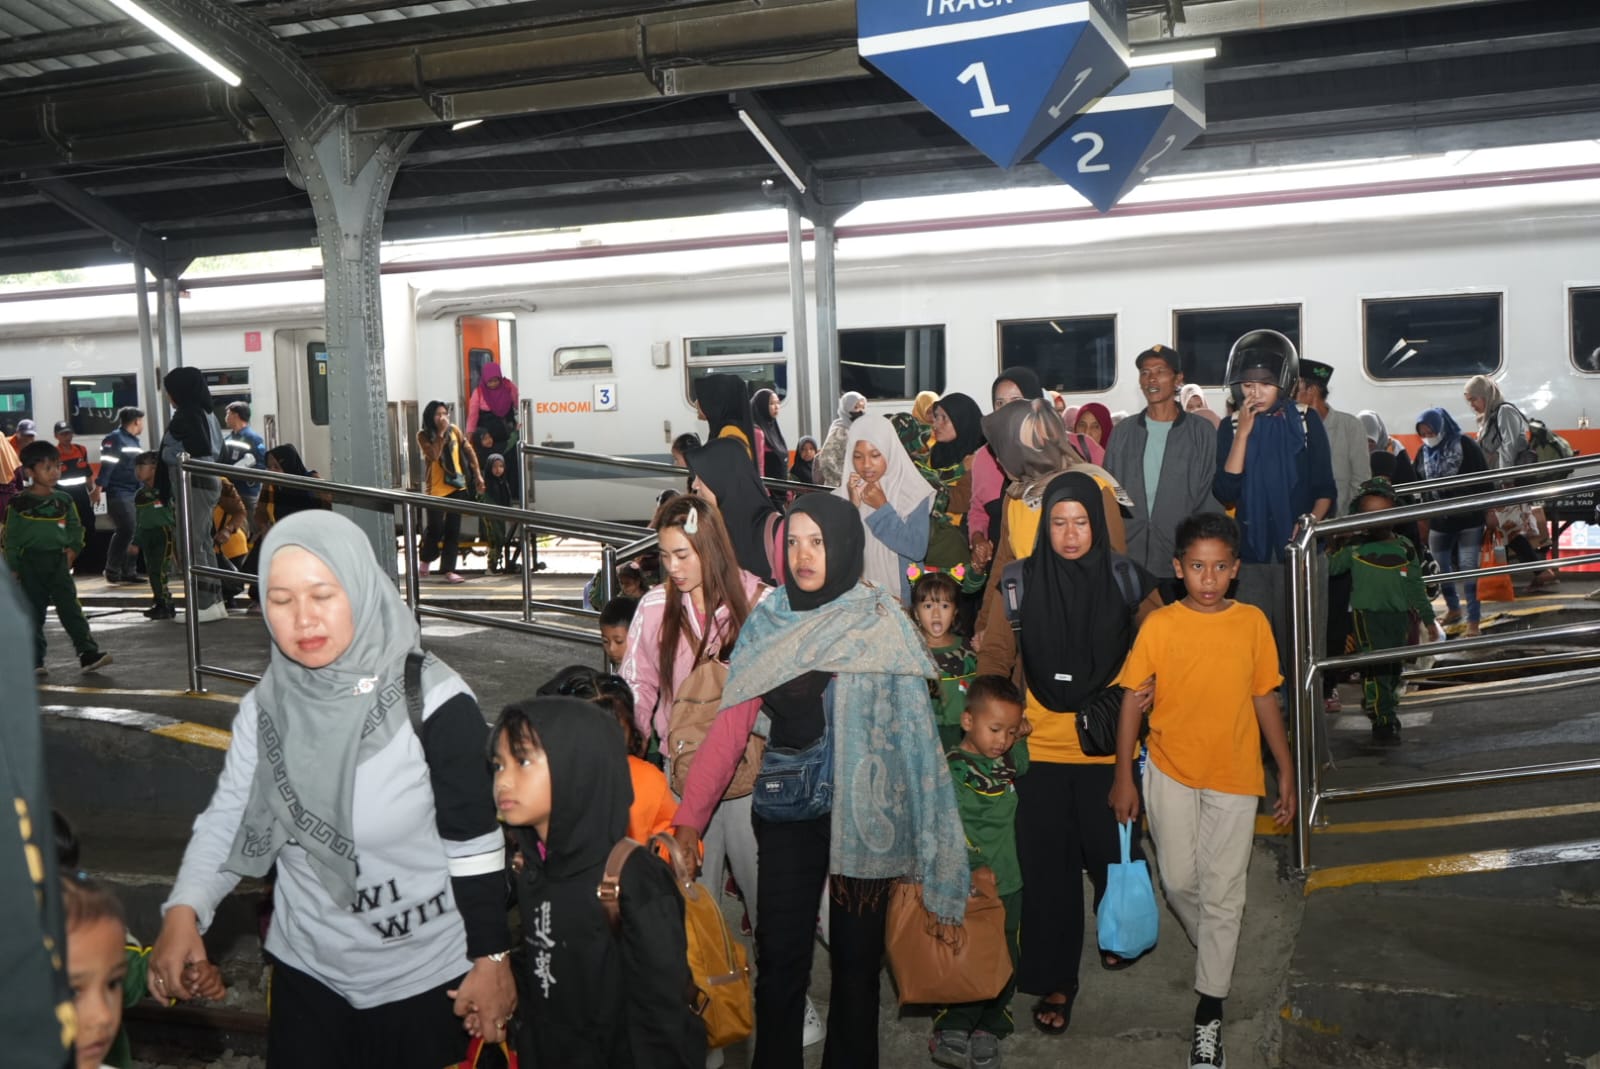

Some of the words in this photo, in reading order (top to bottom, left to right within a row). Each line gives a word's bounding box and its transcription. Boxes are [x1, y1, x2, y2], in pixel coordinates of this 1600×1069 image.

[926, 0, 1013, 17] TRA
[956, 61, 1010, 118] 1
[1071, 131, 1111, 174] 2
[600, 389, 610, 405] 3
[536, 401, 592, 414] EKONOMI
